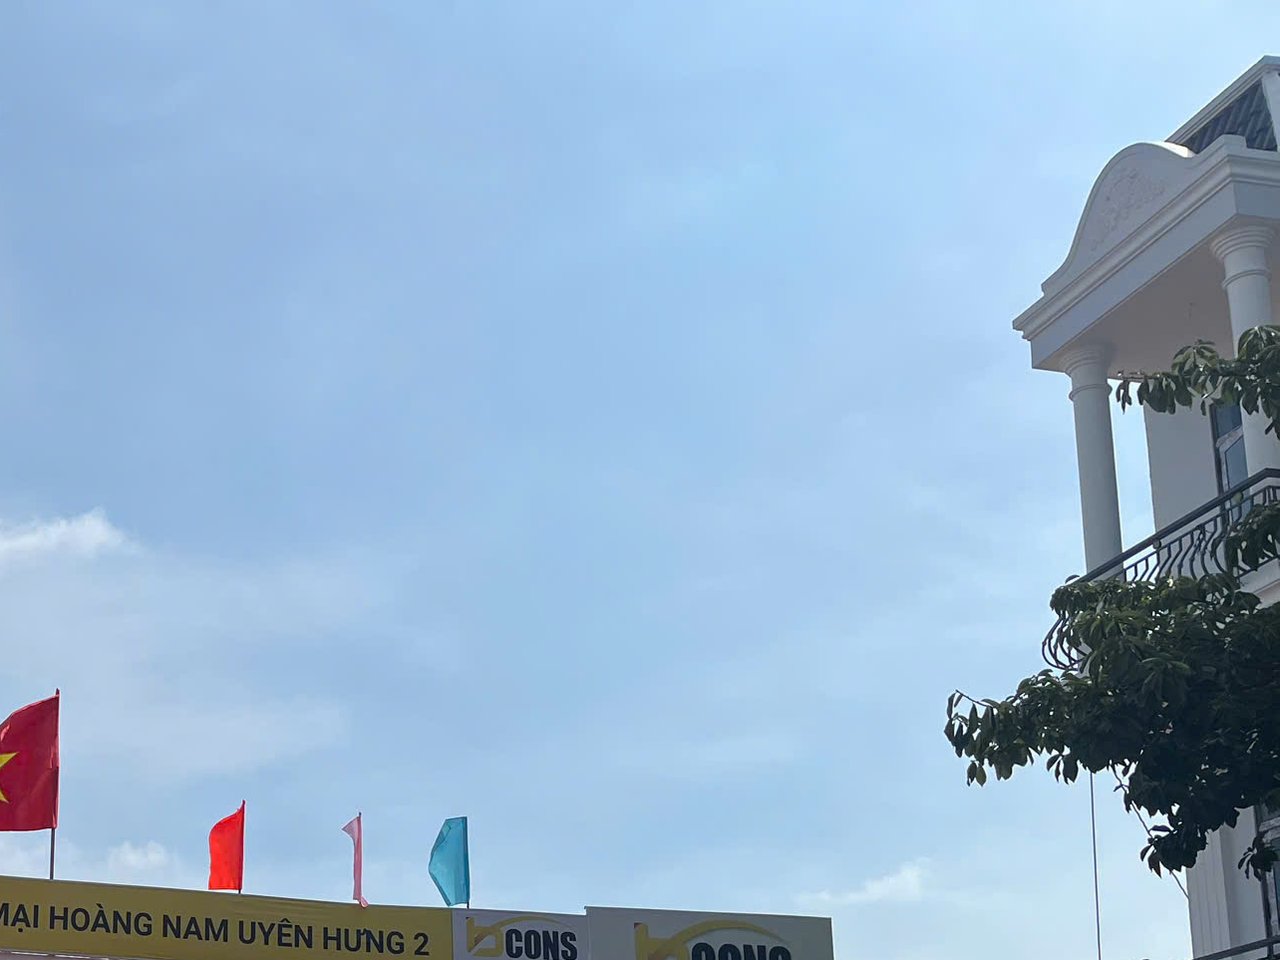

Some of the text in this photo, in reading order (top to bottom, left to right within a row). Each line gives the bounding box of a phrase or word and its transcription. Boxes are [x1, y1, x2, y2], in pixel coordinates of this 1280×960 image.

[47, 902, 153, 937] HOÀNG
[162, 914, 228, 942] NAM
[238, 917, 314, 949] UYÊN
[322, 926, 404, 955] HƯNG
[413, 932, 430, 957] 2
